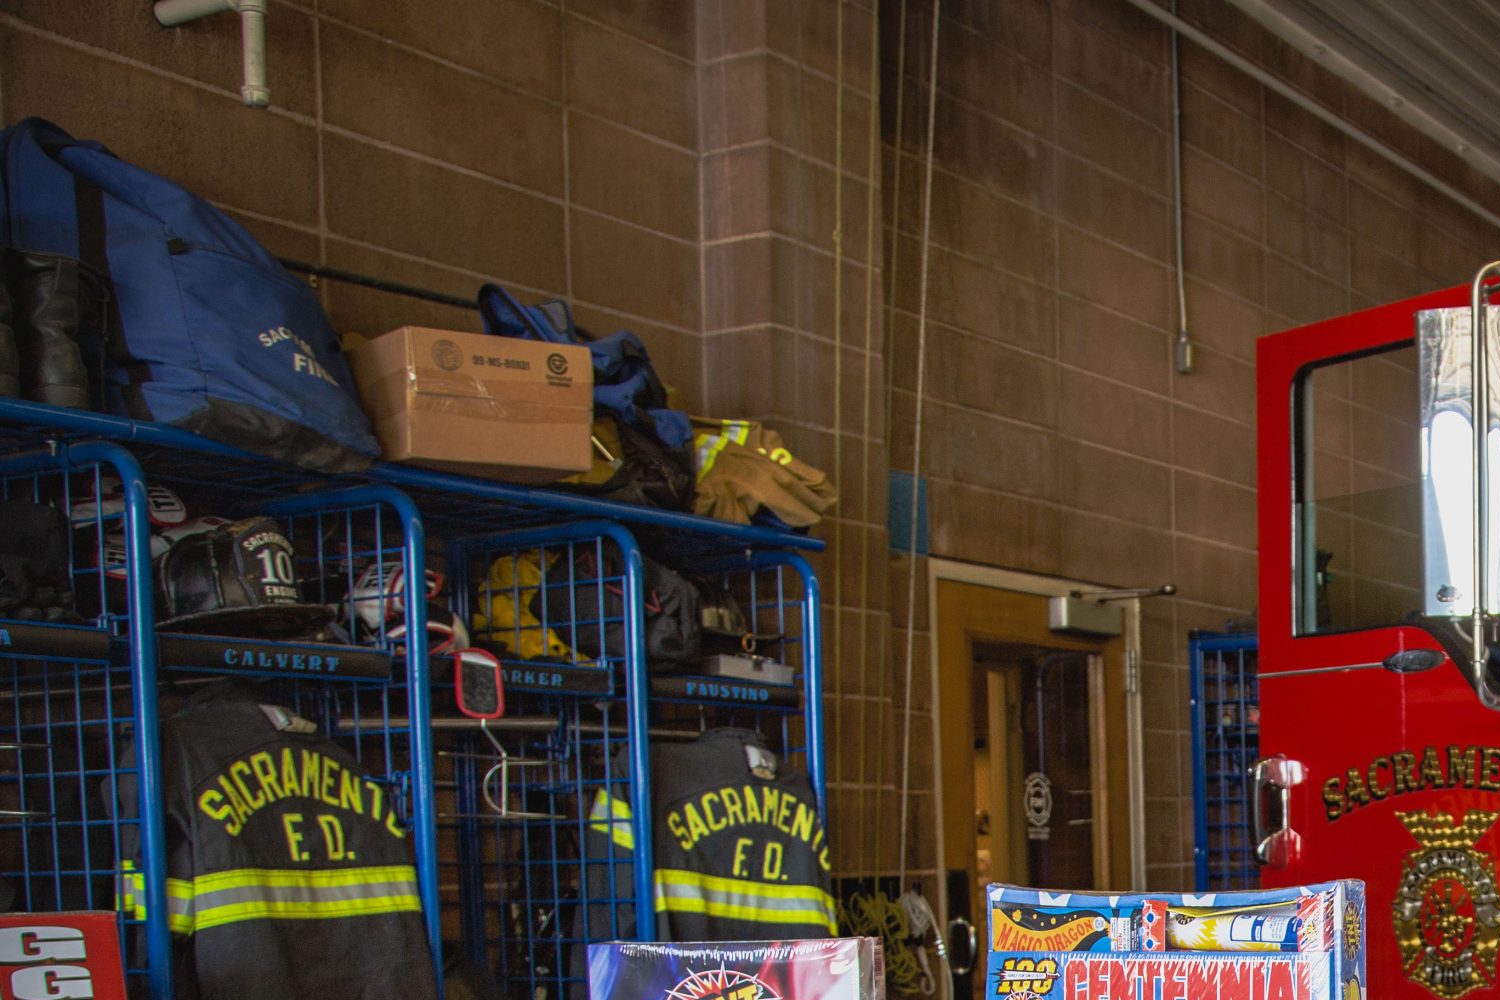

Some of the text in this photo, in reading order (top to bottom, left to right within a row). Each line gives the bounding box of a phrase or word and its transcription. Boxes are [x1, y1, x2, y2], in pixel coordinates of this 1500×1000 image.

[256, 548, 294, 585] 10
[223, 648, 341, 673] CALVERT
[685, 681, 769, 702] FAUSTINO
[997, 918, 1095, 952] MAGIC DRAGON
[1346, 910, 1360, 948] TNT
[997, 958, 1058, 994] 100
[1429, 963, 1470, 985] FIRE
